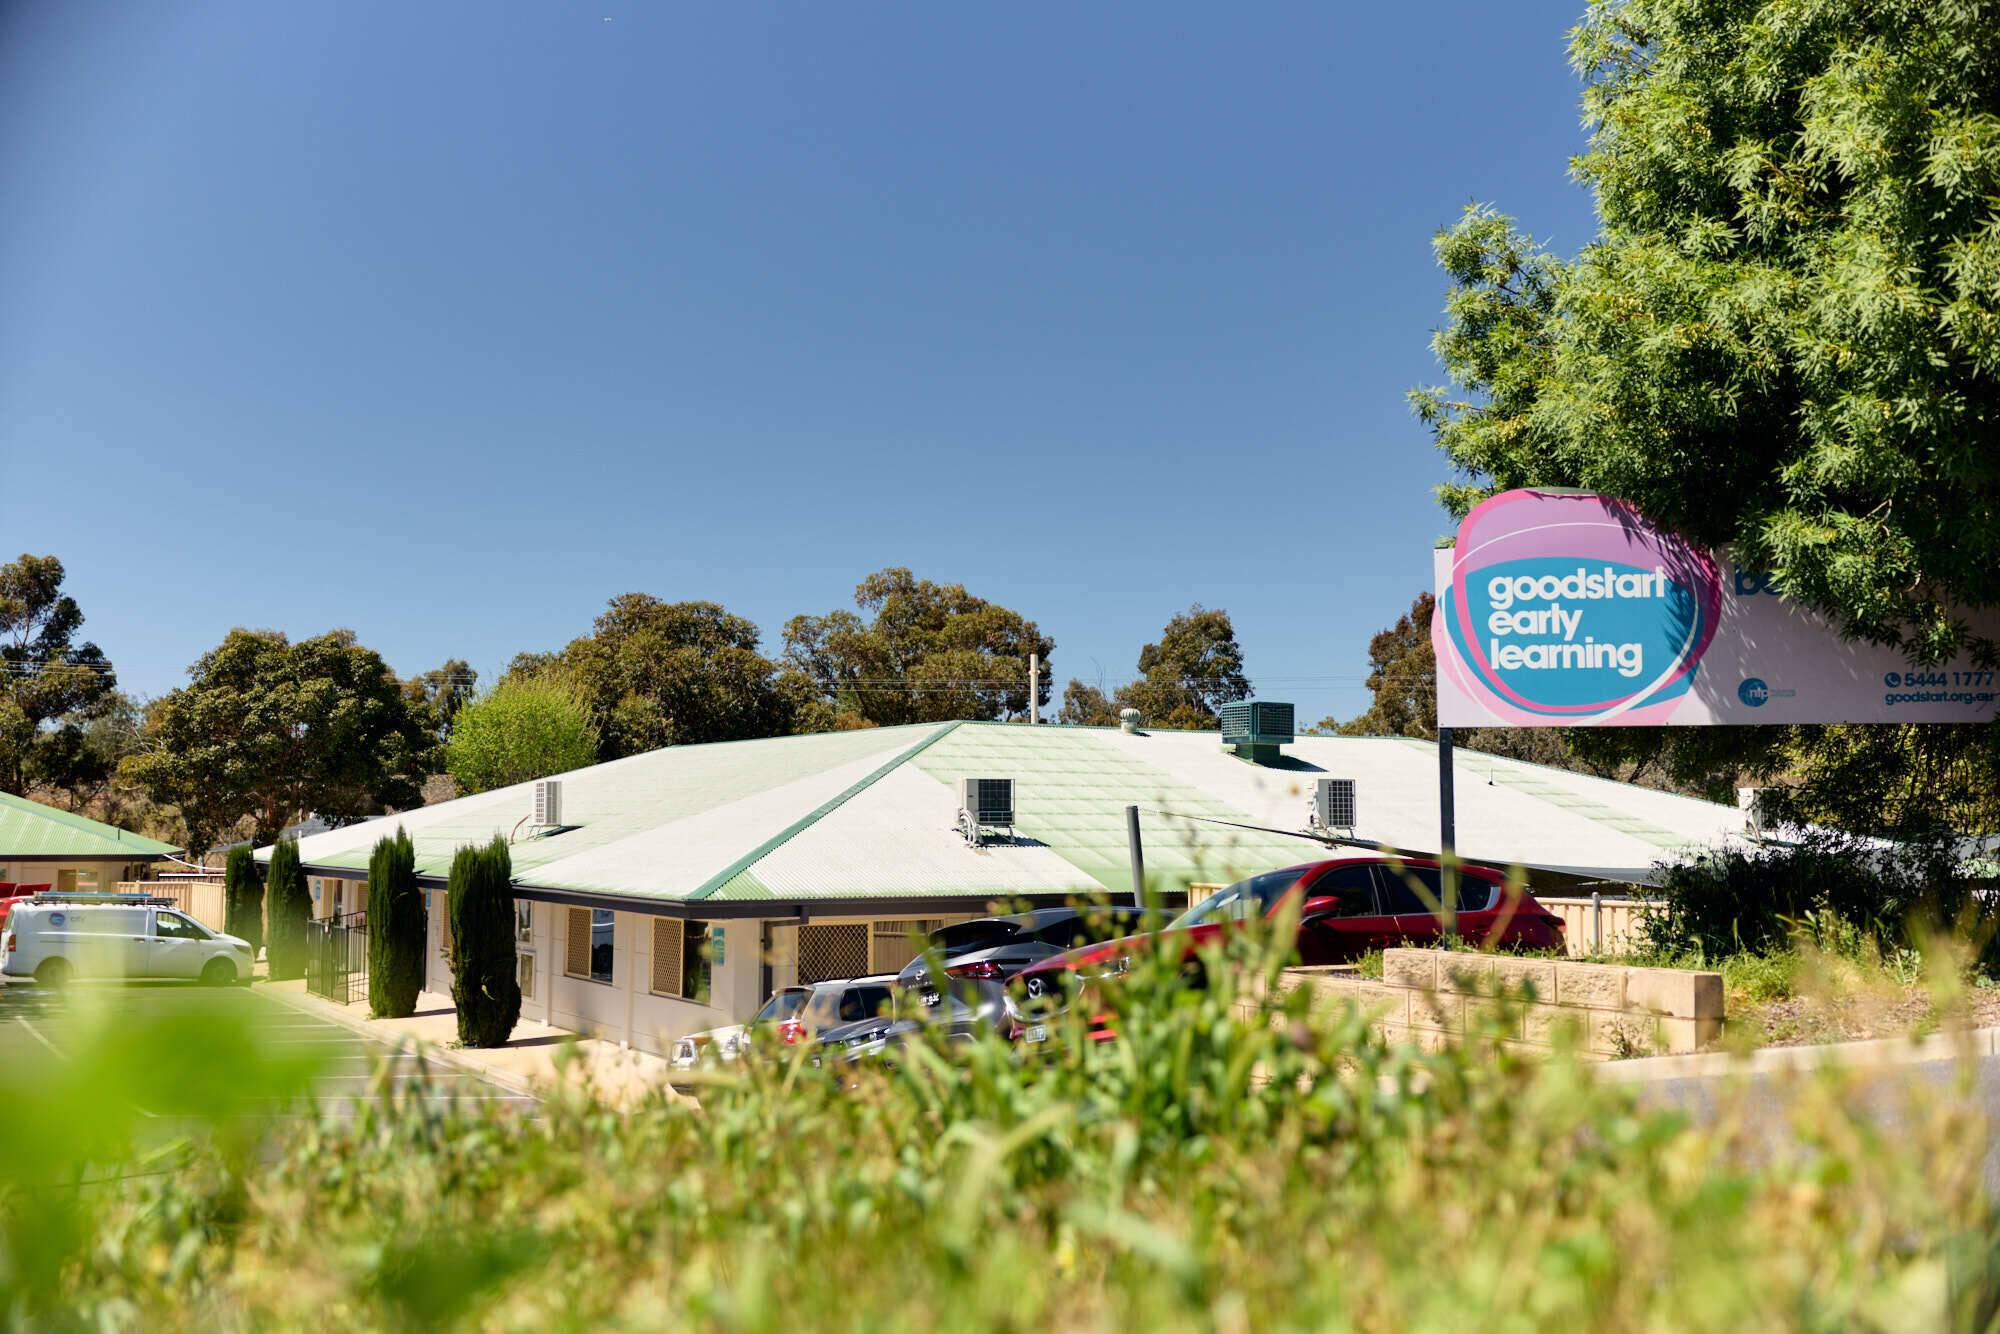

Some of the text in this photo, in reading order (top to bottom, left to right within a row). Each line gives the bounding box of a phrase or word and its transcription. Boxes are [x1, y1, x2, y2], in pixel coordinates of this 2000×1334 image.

[1488, 566, 1665, 610] goodstart
[1488, 603, 1583, 641] early
[1490, 636, 1643, 678] learning
[1885, 691, 1994, 705] goodstart.org.au
[1904, 672, 1994, 687] 5444 1777
